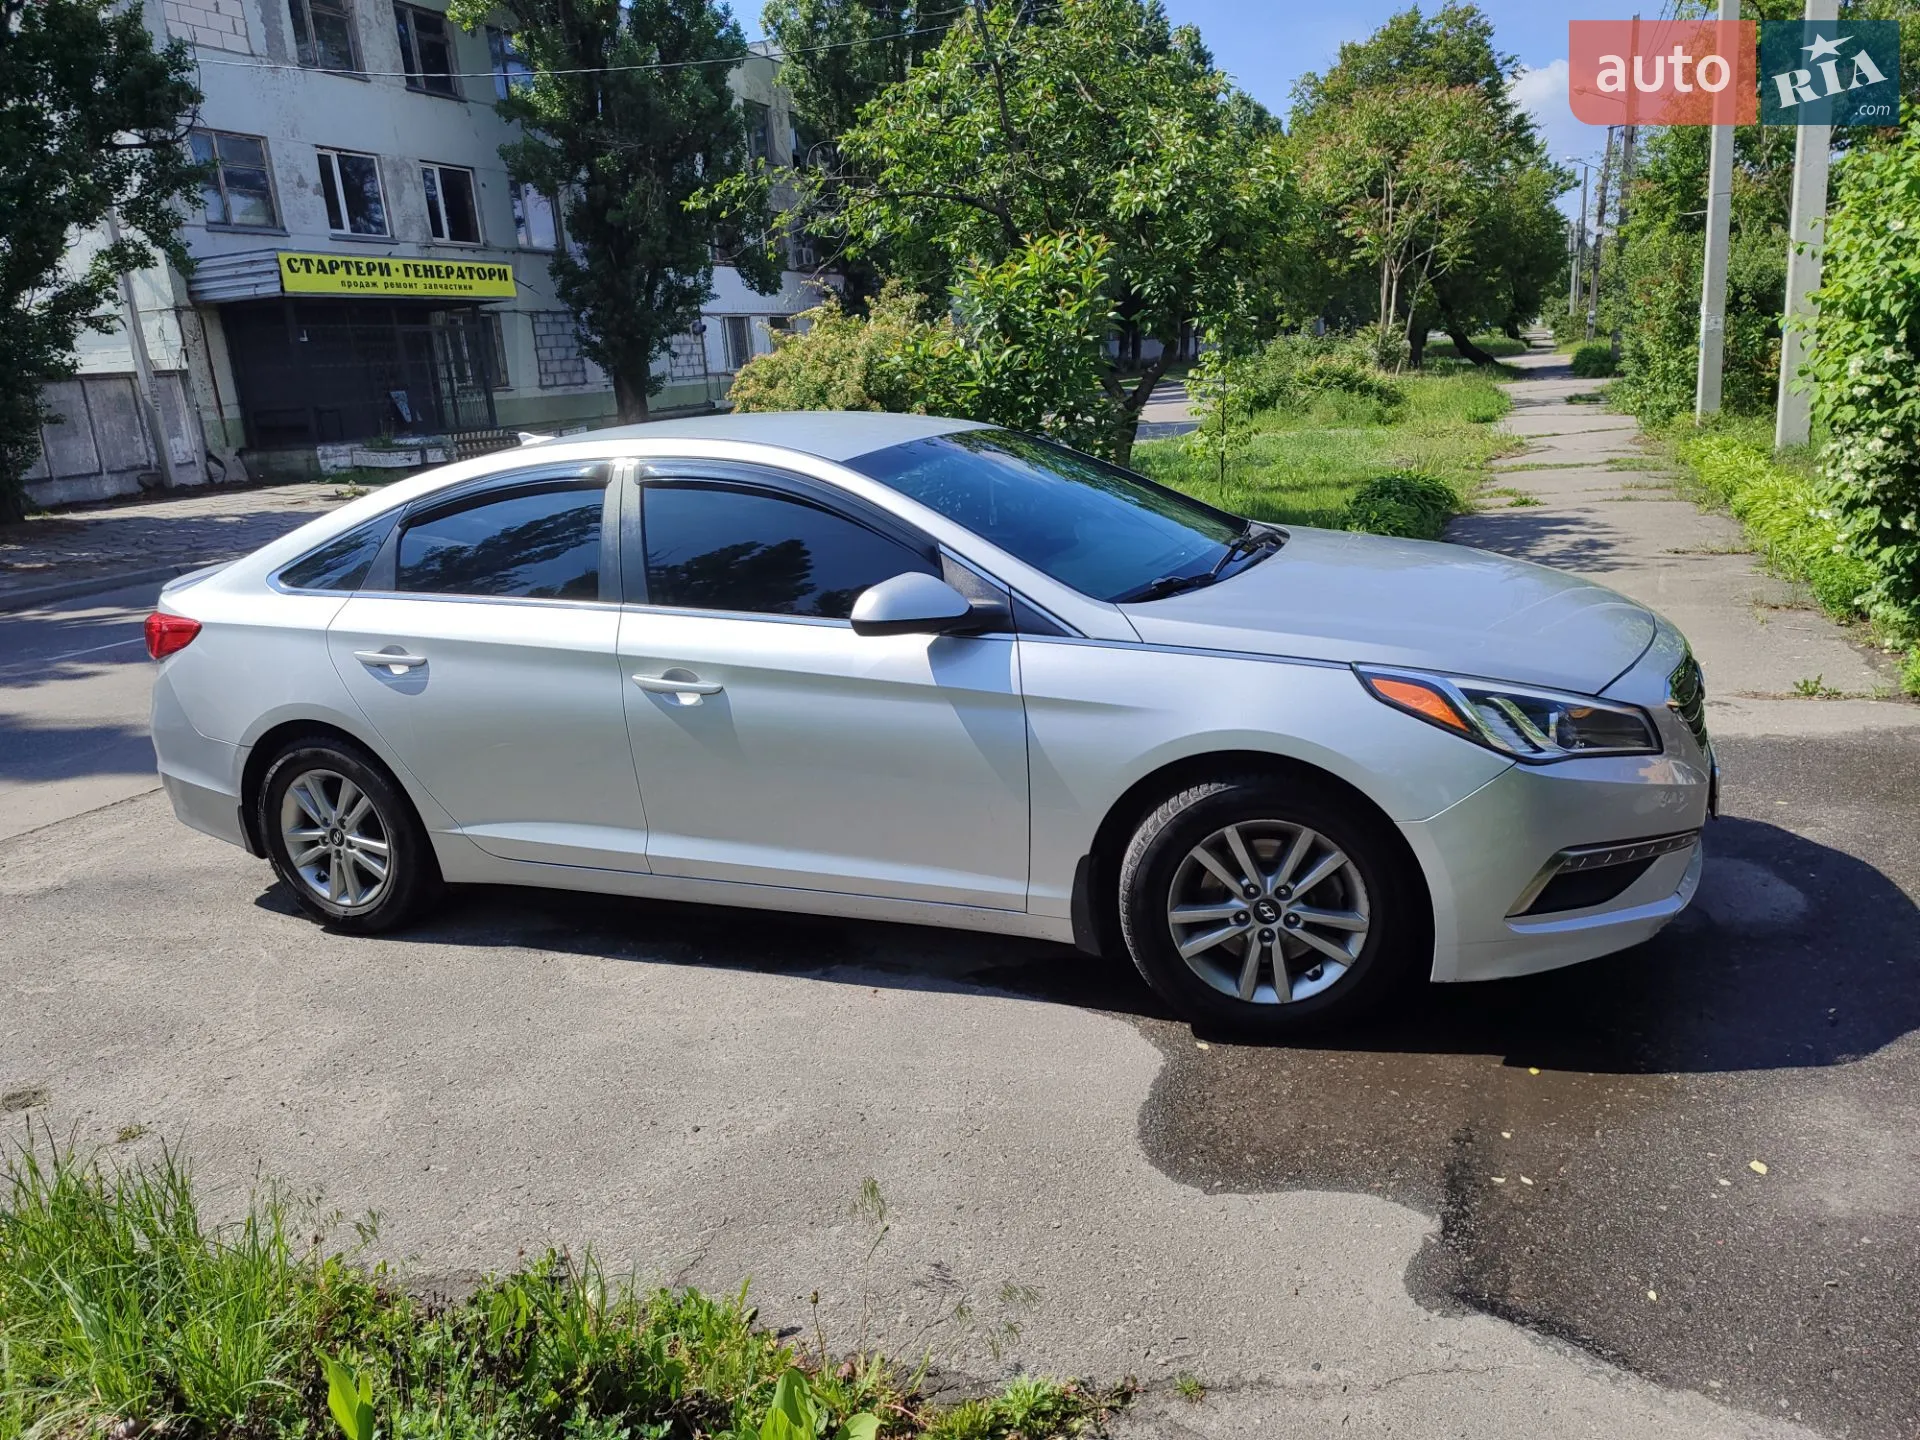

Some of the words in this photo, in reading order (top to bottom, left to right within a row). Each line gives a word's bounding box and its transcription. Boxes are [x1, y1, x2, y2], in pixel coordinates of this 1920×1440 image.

[286, 257, 392, 278] СТАРТЕРИ
[403, 263, 509, 282] ГЕНЕРАТОРИ
[340, 280, 379, 289] продаж
[384, 281, 418, 290] ремонт
